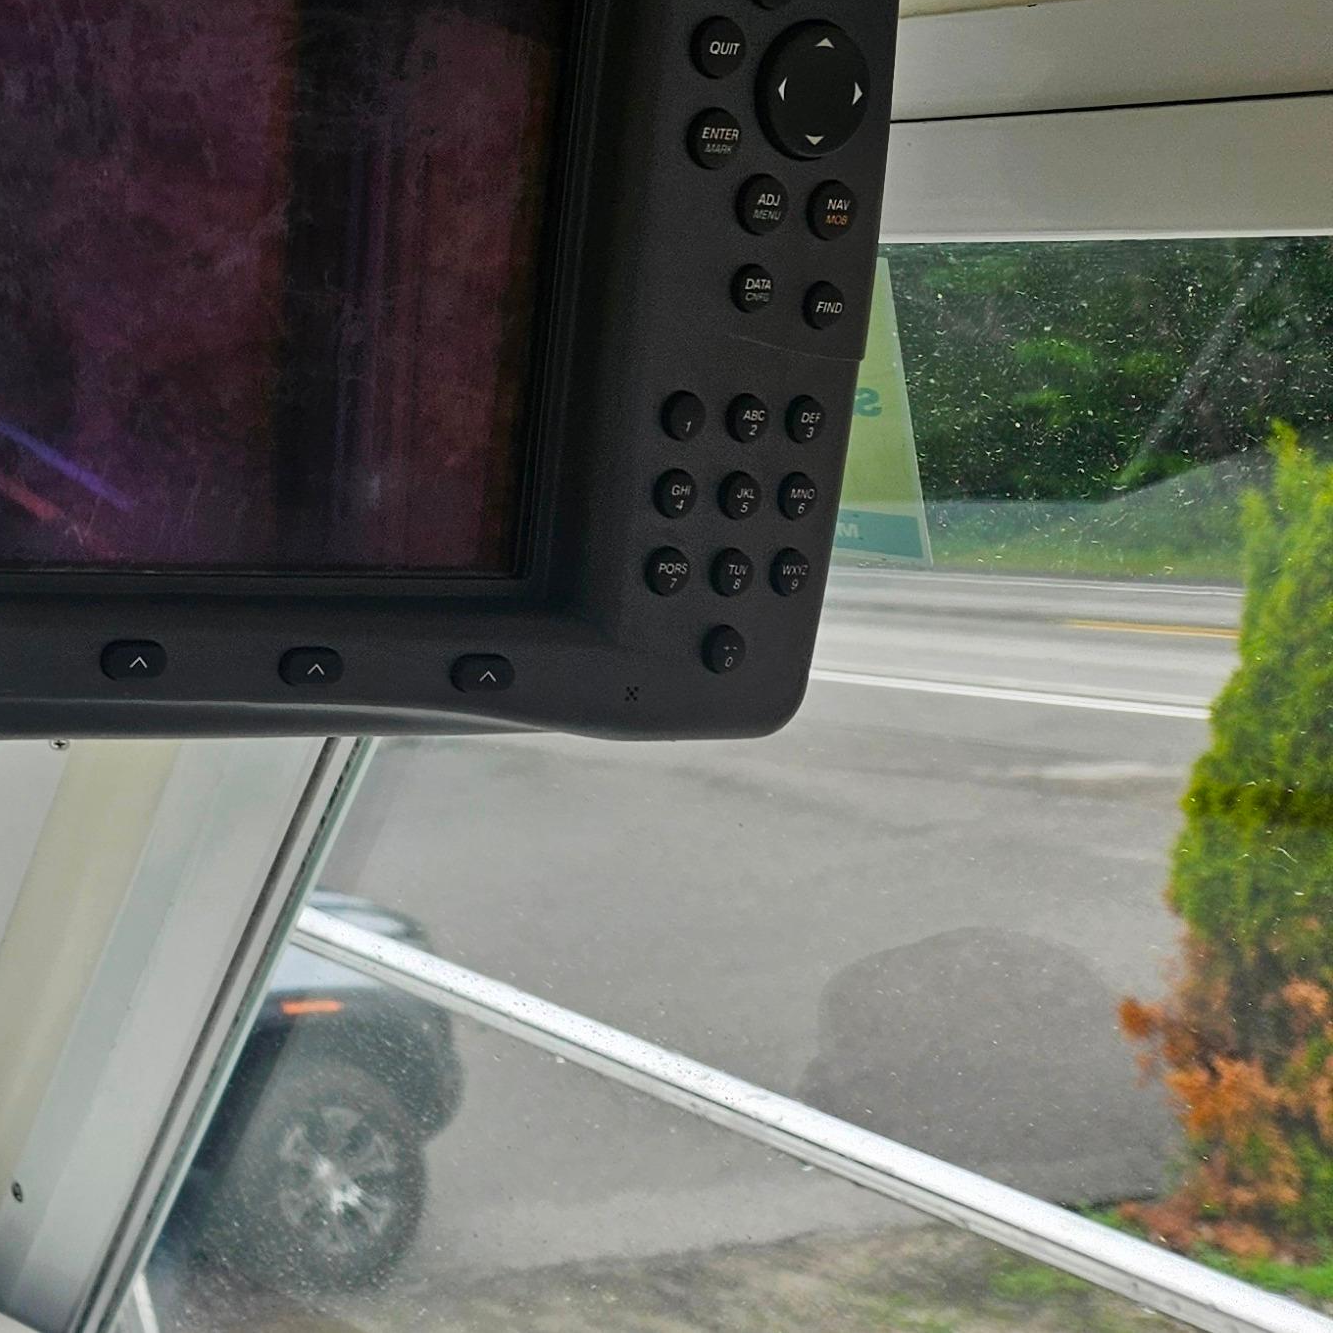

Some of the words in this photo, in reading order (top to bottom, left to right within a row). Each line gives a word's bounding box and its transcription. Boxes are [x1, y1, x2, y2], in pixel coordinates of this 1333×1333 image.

[709, 40, 741, 56] QUIT
[701, 127, 740, 141] ENTER
[705, 143, 733, 154] MARK
[757, 193, 781, 207] ADJ
[827, 198, 851, 211] NAV
[753, 209, 781, 220] MENU
[825, 215, 848, 225] MOB
[744, 278, 771, 291] DATA
[816, 301, 843, 314] FIND
[743, 410, 765, 422] ABC
[801, 411, 821, 424] DEF
[684, 420, 692, 433] 1
[749, 424, 758, 436] 2
[806, 426, 814, 438] 3
[671, 484, 691, 497] GHI
[736, 487, 755, 500] JKL
[790, 488, 816, 500] MNO
[675, 499, 684, 511] 4
[740, 501, 749, 513] 5
[797, 502, 806, 515] 6
[728, 564, 749, 576] TUV
[782, 564, 808, 576] WXYZ
[669, 577, 678, 589] 7
[733, 577, 741, 590] 8
[790, 578, 799, 590] 9
[725, 655, 734, 668] 0
